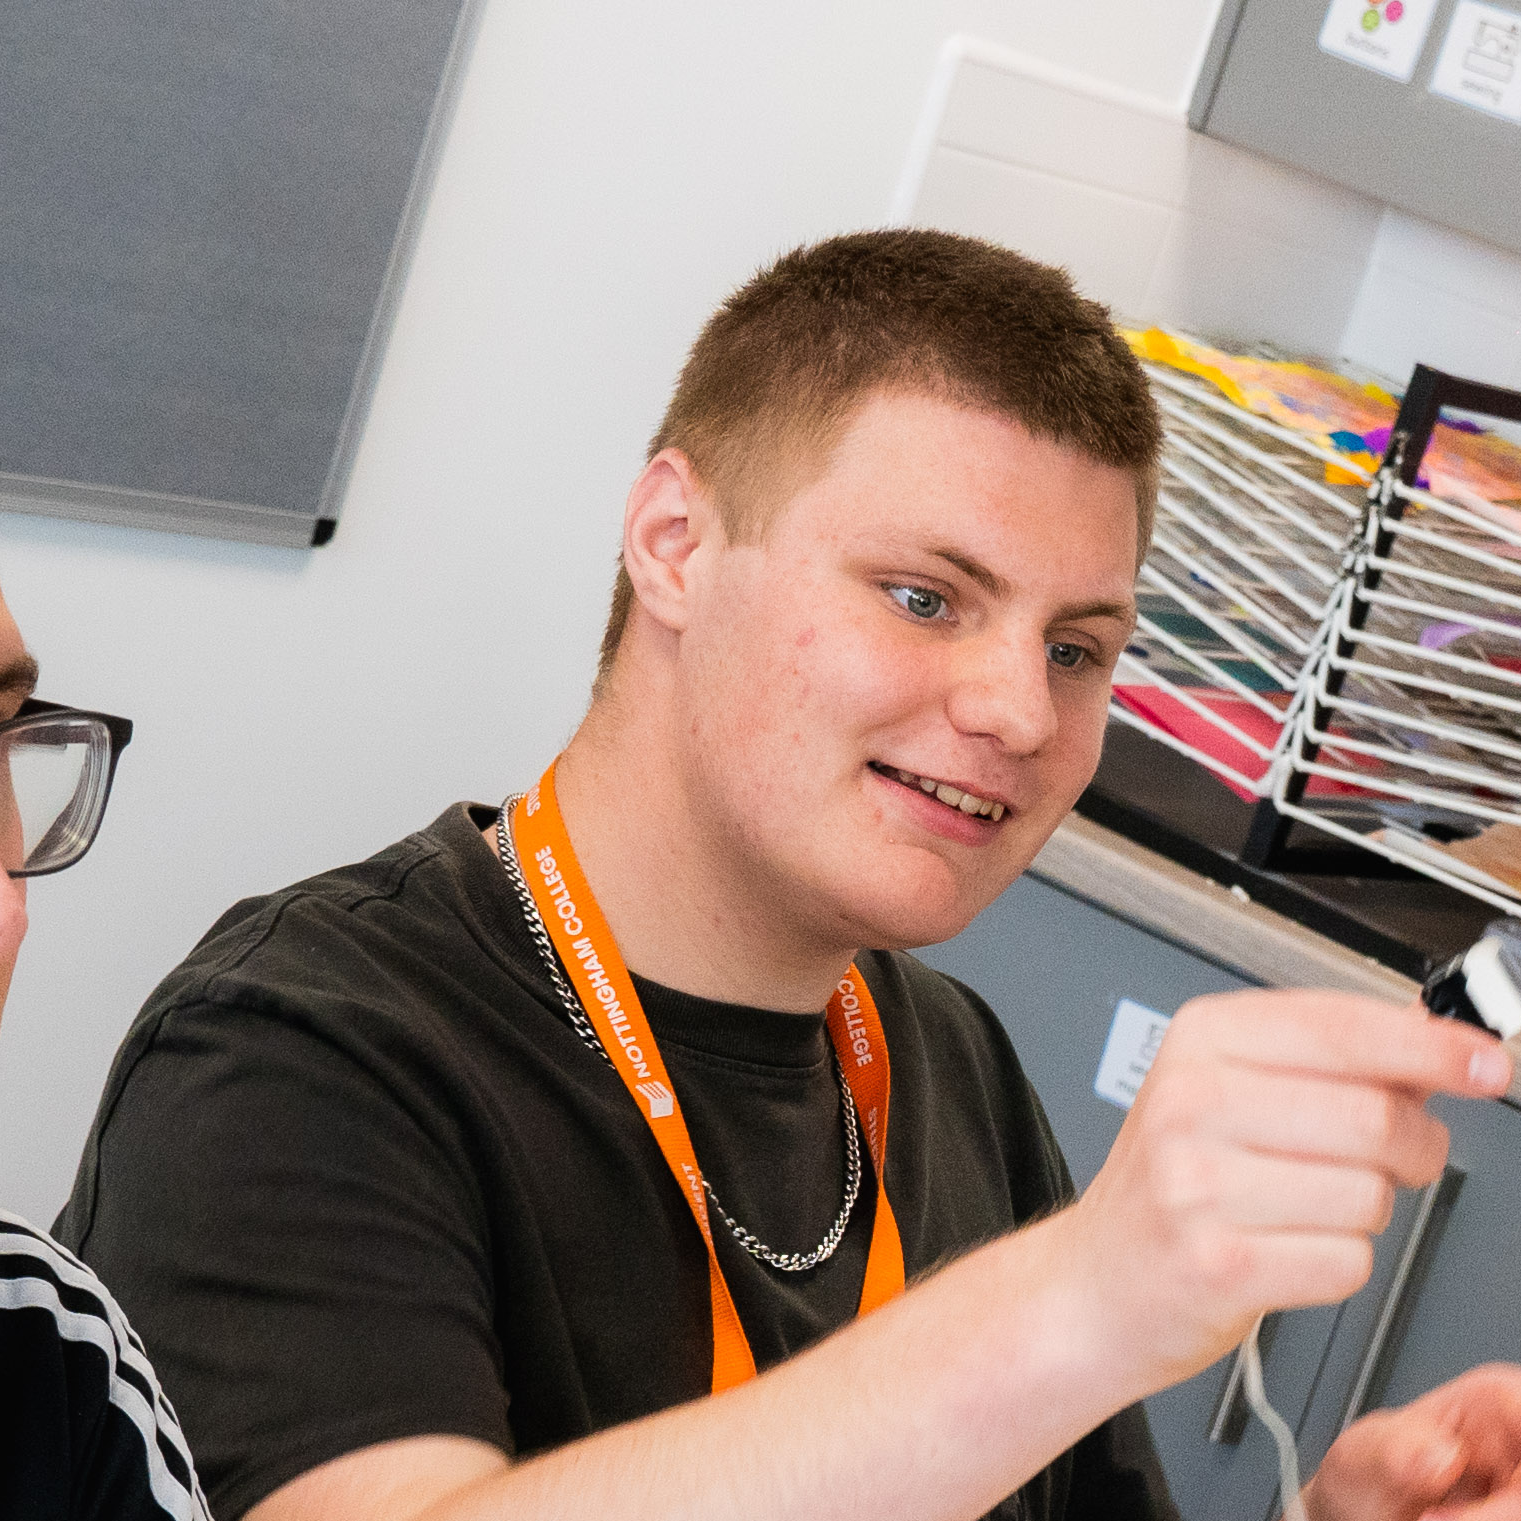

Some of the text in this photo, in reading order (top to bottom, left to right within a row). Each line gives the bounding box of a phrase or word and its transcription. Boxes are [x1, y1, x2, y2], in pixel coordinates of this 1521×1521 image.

[534, 845, 652, 1079] NOTTINGHAM COLLEGE
[836, 978, 874, 1068] COLLEGE
